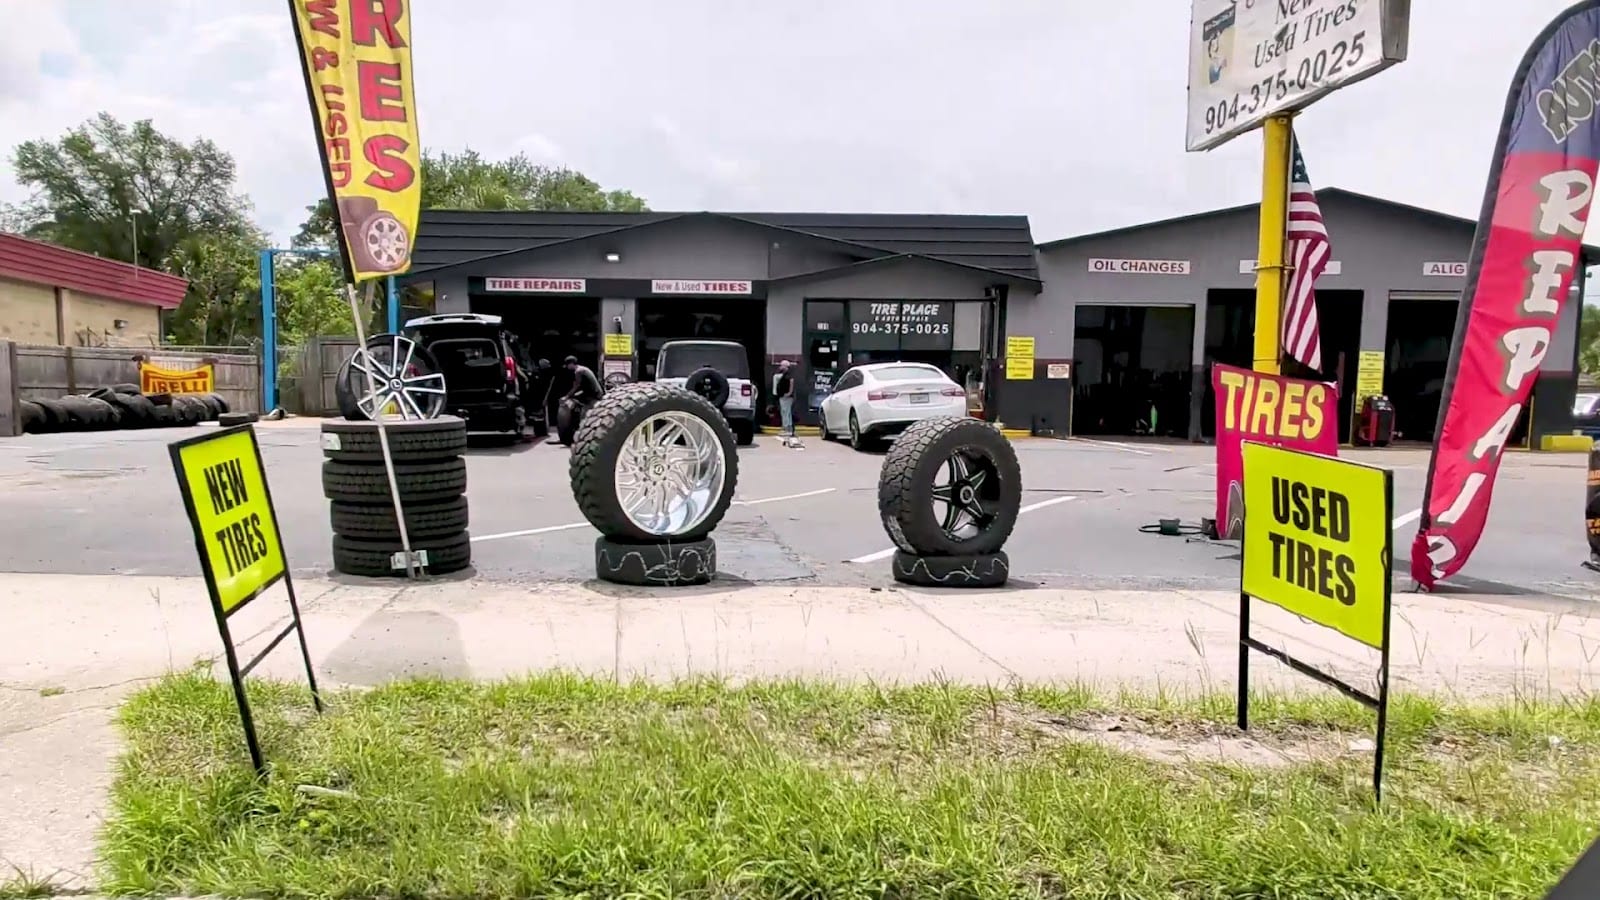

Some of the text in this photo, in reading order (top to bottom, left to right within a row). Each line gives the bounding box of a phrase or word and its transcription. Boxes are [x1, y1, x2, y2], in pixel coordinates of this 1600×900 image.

[311, 46, 340, 72] &
[1255, 0, 1357, 68] Used Tires
[1206, 30, 1366, 135] 904-375-0025
[1536, 38, 1600, 144] AUT
[320, 84, 352, 188] USED
[490, 279, 582, 291] TIRE REPAIRS
[655, 281, 748, 292] New & Used TIRES
[1094, 260, 1185, 273] OIL CHANGES
[1430, 263, 1465, 274] ALIG
[852, 322, 949, 334] 904-375-0025
[870, 303, 940, 315] TIRE PLACE
[1220, 371, 1326, 440] TIRES
[203, 457, 249, 516] NEW
[1271, 476, 1350, 543] USED
[215, 512, 268, 578] TIRES
[1268, 531, 1357, 606] TIRES
